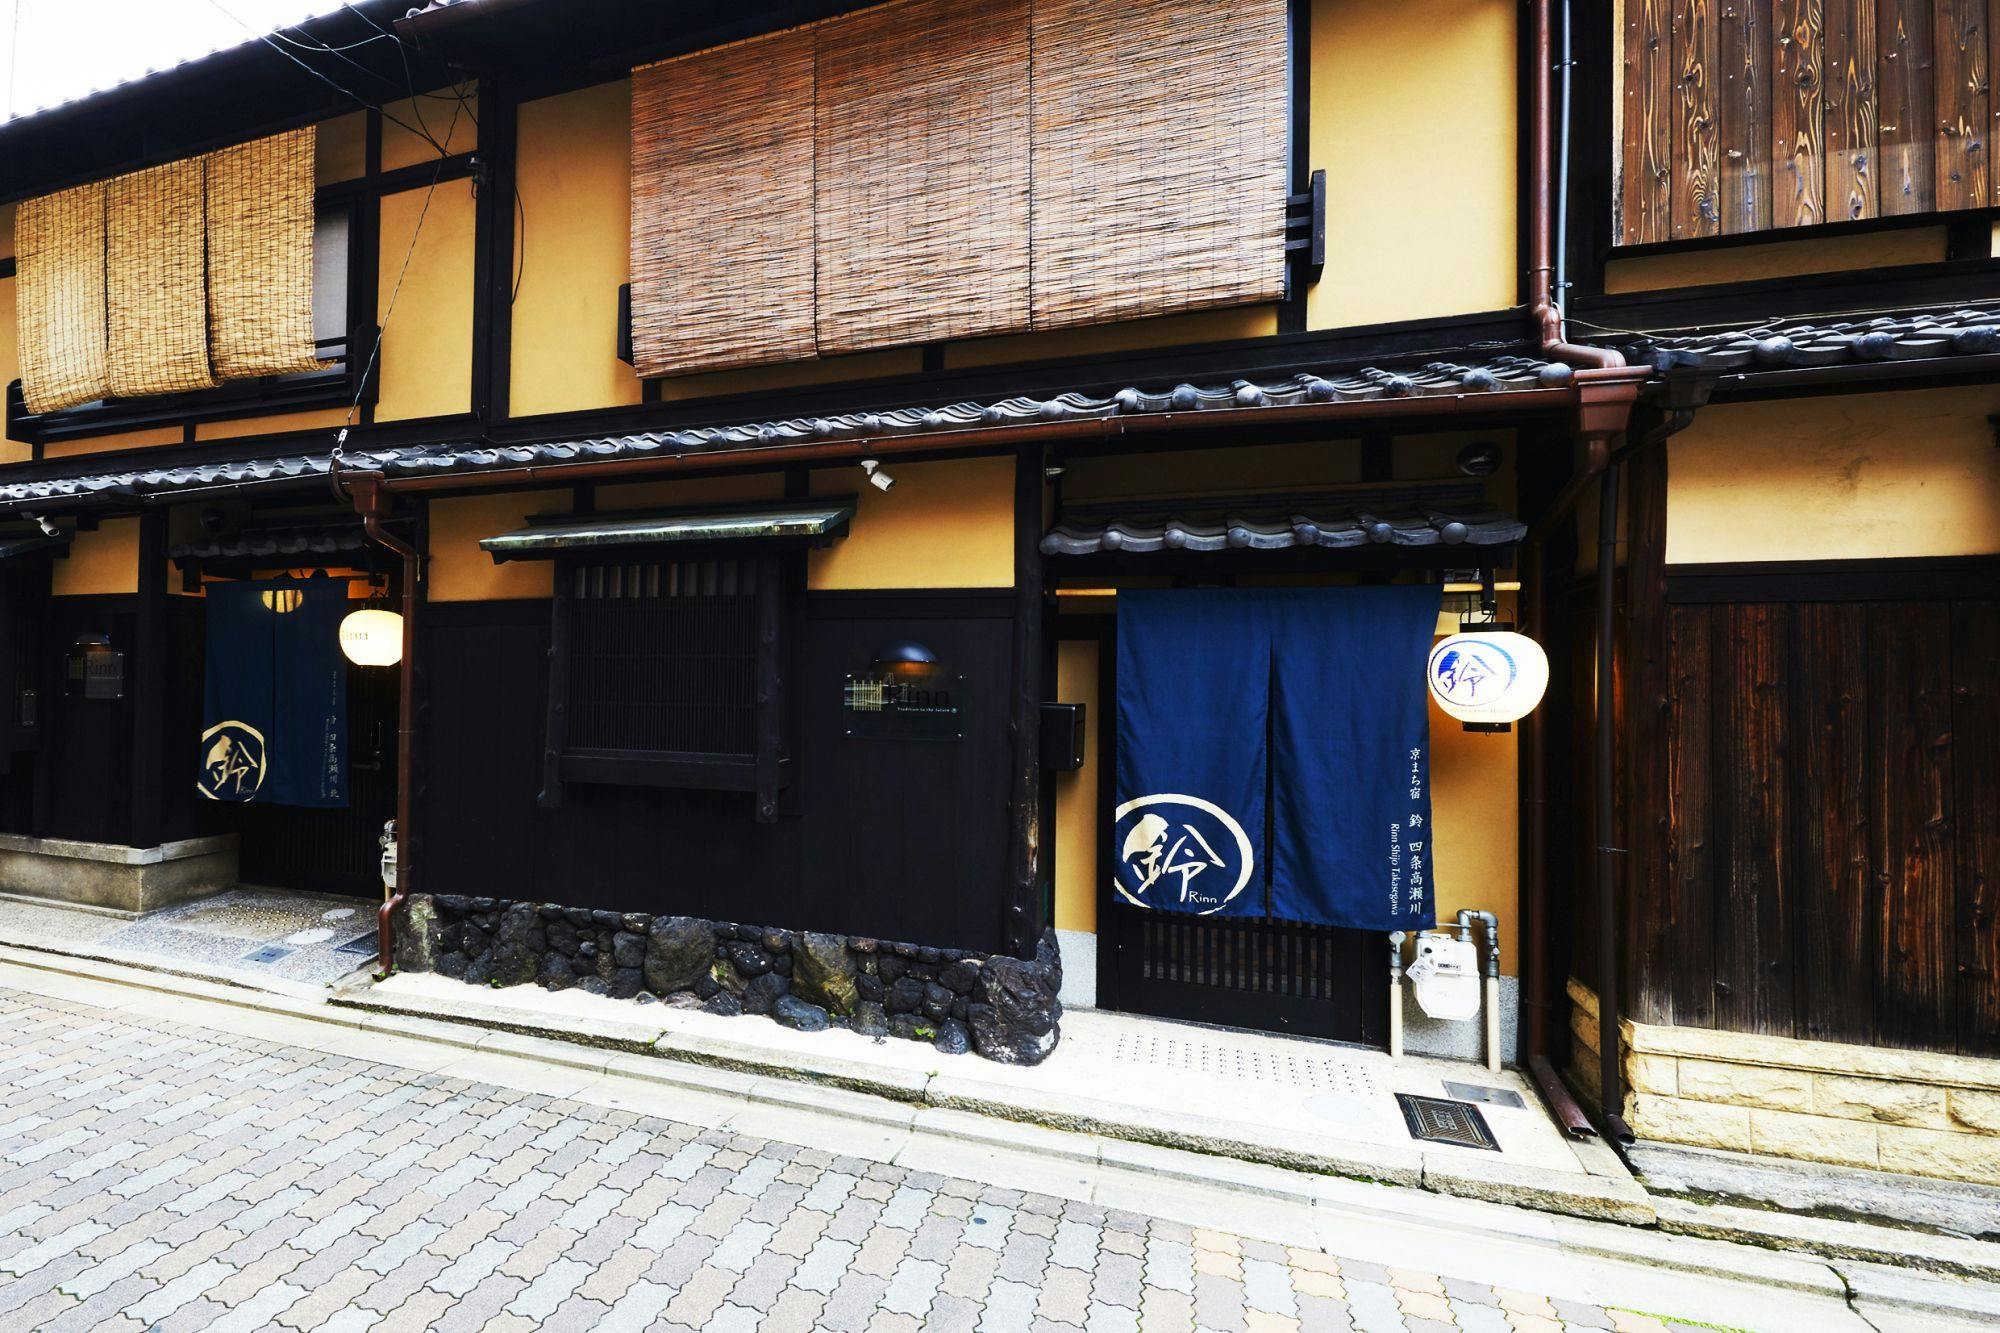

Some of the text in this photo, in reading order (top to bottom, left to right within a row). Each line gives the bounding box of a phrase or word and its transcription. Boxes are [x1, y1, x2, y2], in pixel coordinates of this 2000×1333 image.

[1122, 813, 1226, 903] 鈴
[1389, 823, 1401, 915] Rinn Shijo Takasegawa
[1409, 747, 1423, 914] 京まち宿 鈴 四条高瀬川
[1188, 891, 1218, 904] Rinn
